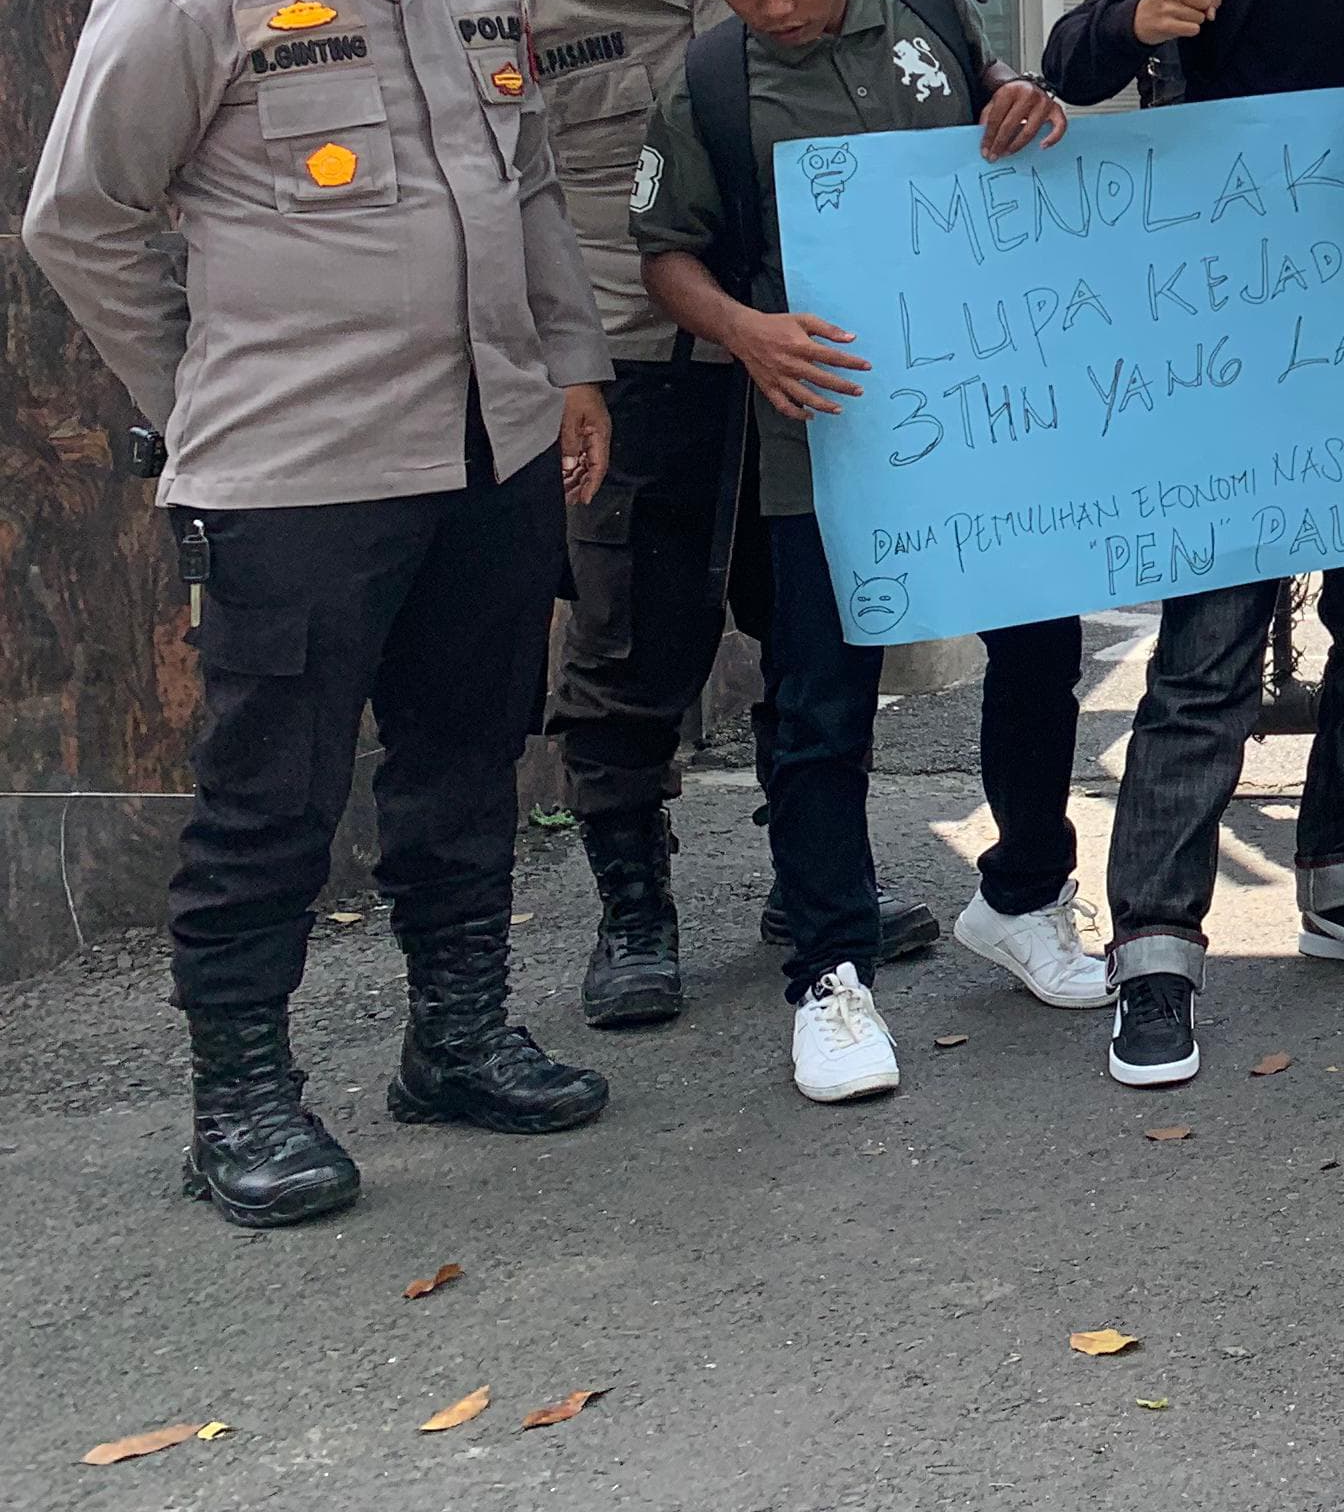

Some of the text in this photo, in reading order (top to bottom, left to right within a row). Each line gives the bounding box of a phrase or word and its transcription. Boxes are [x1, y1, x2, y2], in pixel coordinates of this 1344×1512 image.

[899, 279, 1112, 368] LUPA
[1088, 334, 1243, 437] YANG
[872, 525, 937, 565] DANA
[943, 494, 1120, 574] PEMULIHAN
[1131, 464, 1258, 519] EKONOMI
